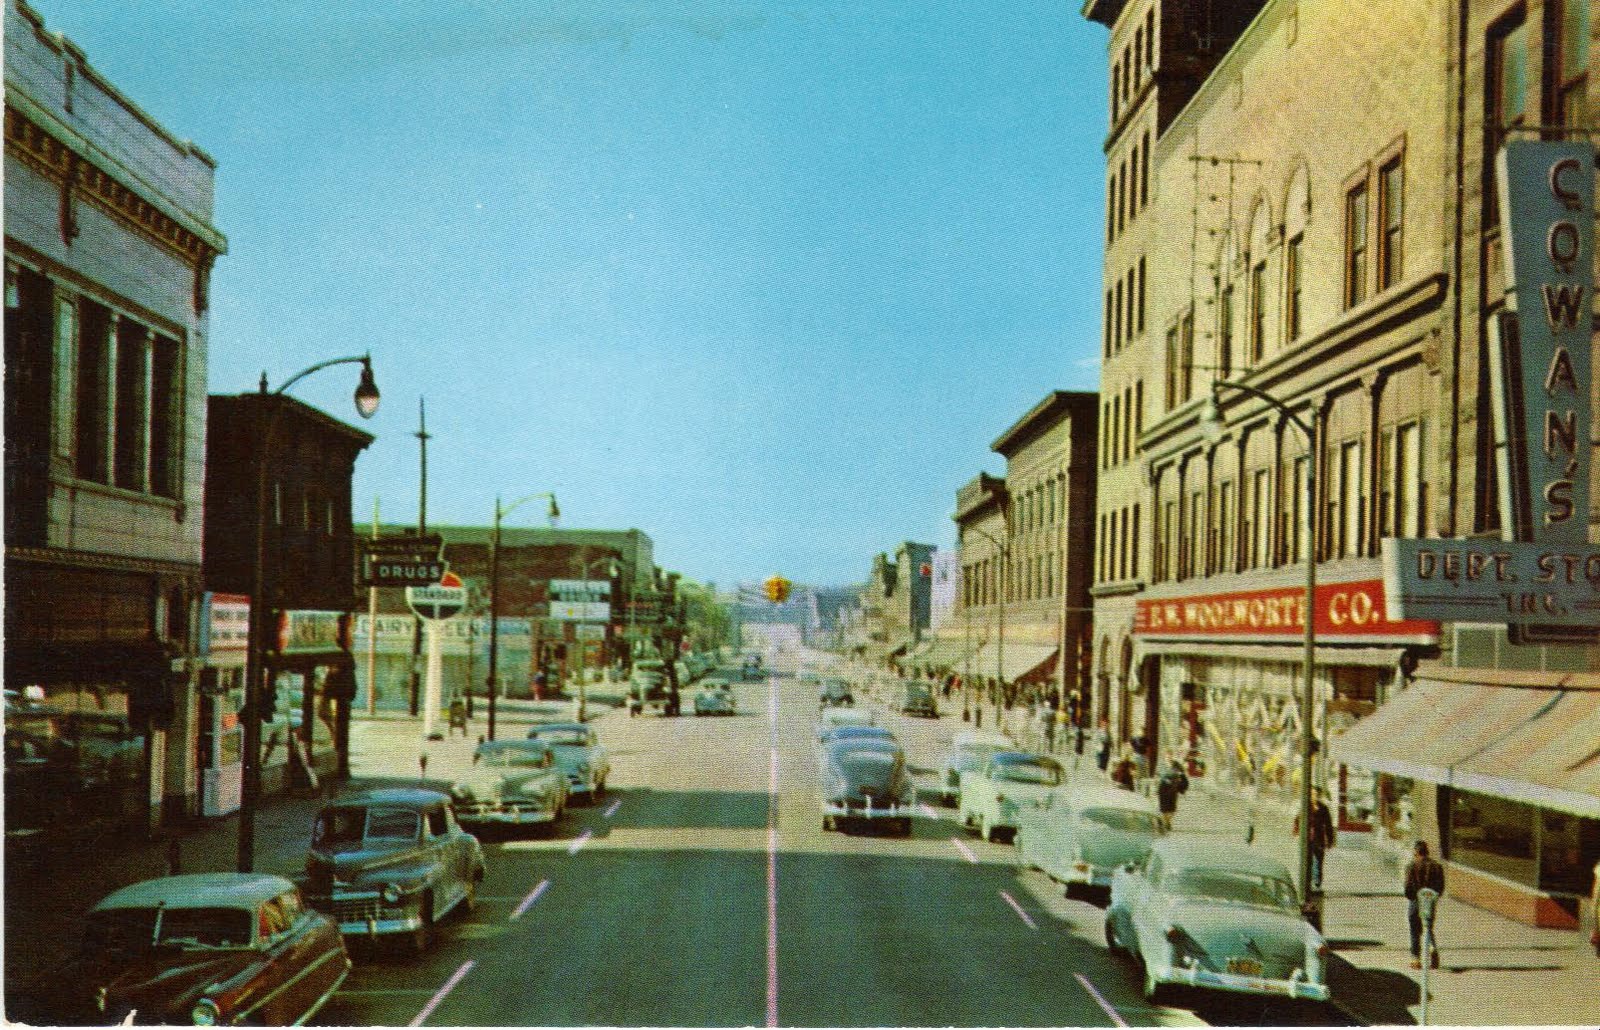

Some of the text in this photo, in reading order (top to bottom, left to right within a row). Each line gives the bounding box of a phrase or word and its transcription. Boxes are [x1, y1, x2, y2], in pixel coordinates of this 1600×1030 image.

[1542, 157, 1584, 525] COWAN'S
[379, 565, 440, 579] DRUGS
[1418, 549, 1518, 584] DEPT.
[1328, 592, 1379, 625] CO.
